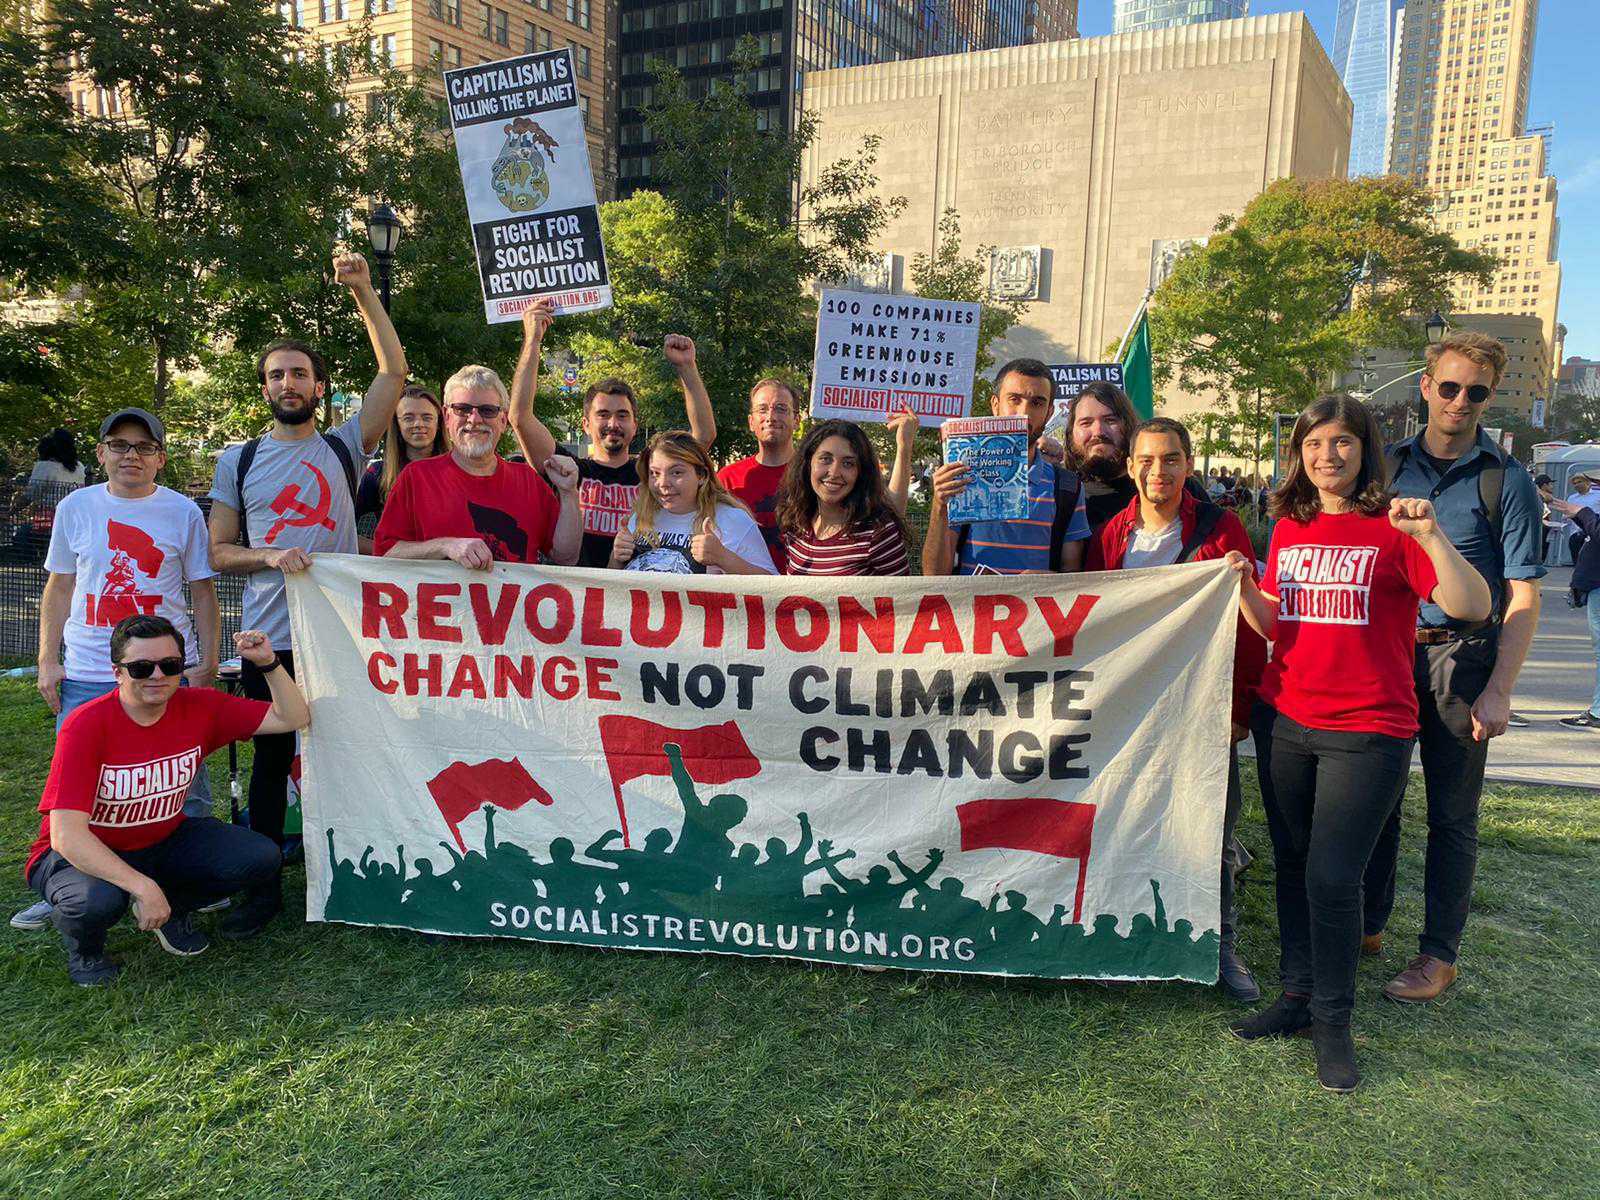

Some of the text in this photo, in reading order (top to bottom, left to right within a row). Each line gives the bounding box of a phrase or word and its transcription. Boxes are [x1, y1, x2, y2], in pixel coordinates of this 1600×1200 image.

[451, 57, 568, 99] CAPITALISM IS
[453, 83, 573, 121] KILLING THE PLANET
[977, 104, 1072, 130] BATTERY
[1140, 87, 1240, 118] TUNNEL
[992, 158, 1054, 173] BRIDGE
[973, 203, 1068, 219] AUTHORITY
[492, 214, 581, 246] FIGHT FOR
[494, 237, 585, 270] SOCIALIST
[489, 260, 600, 294] REVOLUTION
[827, 299, 974, 324] 100 COMPANIES
[851, 323, 899, 339] MAKE
[828, 341, 955, 366] GREENHOUSE
[840, 366, 948, 388] EMISSIONS
[1050, 367, 1120, 381] TALISM IS
[1058, 384, 1080, 395] THE
[823, 386, 887, 410] SOCIALIST
[948, 418, 1028, 433] SOCIALIST REVOLUTION
[964, 446, 1014, 457] The Power of
[980, 458, 1012, 467] Working
[980, 469, 1000, 477] Class
[581, 479, 640, 509] SOCIALI
[1278, 548, 1375, 584] SOCIALIST
[1279, 587, 1367, 620] EVOLUTION
[361, 582, 1100, 657] REVOLUTIONARY
[367, 651, 1094, 720] CHANGE NOT CLIMATE
[800, 725, 1092, 784] CHANGE
[100, 751, 198, 800] SOCIALIST
[91, 789, 185, 825] REVOLUTIO
[489, 902, 976, 962] SOCIALISTREVOLUTION.ORG
